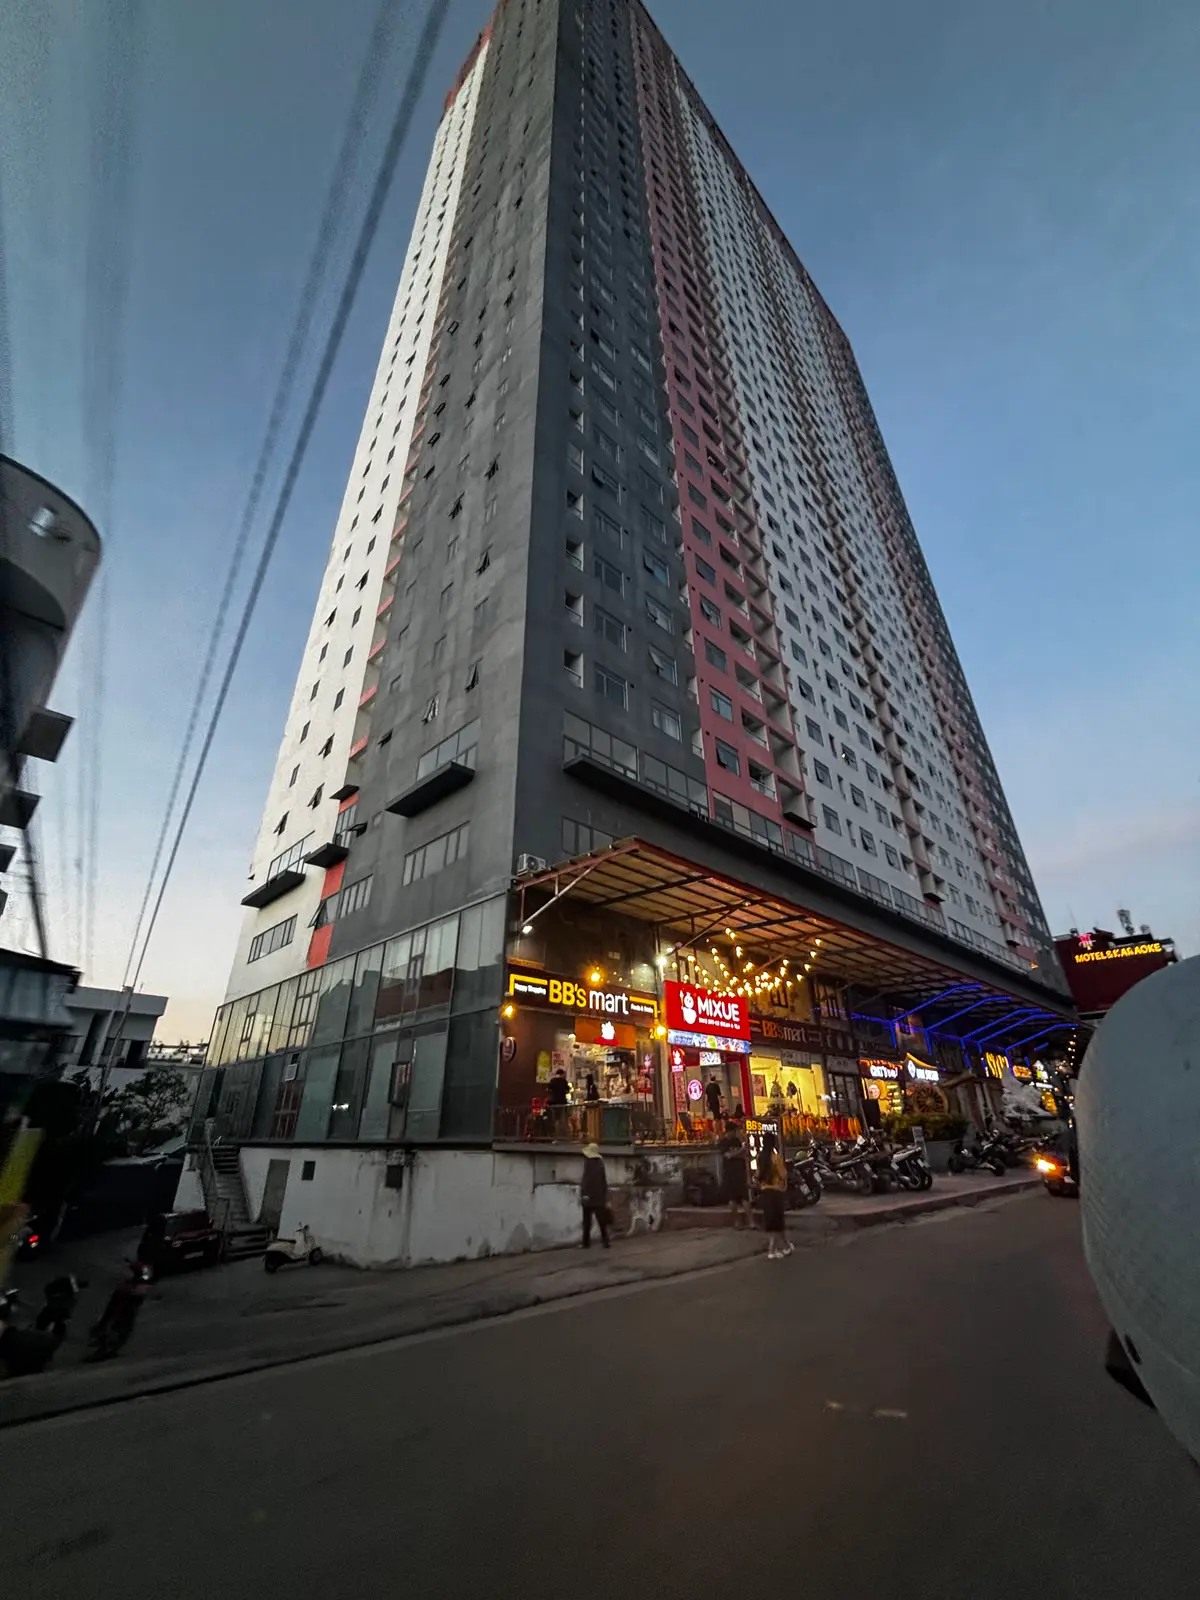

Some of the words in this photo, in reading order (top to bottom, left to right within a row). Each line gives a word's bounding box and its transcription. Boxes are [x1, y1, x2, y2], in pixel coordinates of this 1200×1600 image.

[549, 979, 587, 1008] BB's
[589, 990, 630, 1015] mart
[697, 996, 741, 1022] MIXUE
[783, 1026, 808, 1043] mart
[762, 1123, 777, 1131] mart
